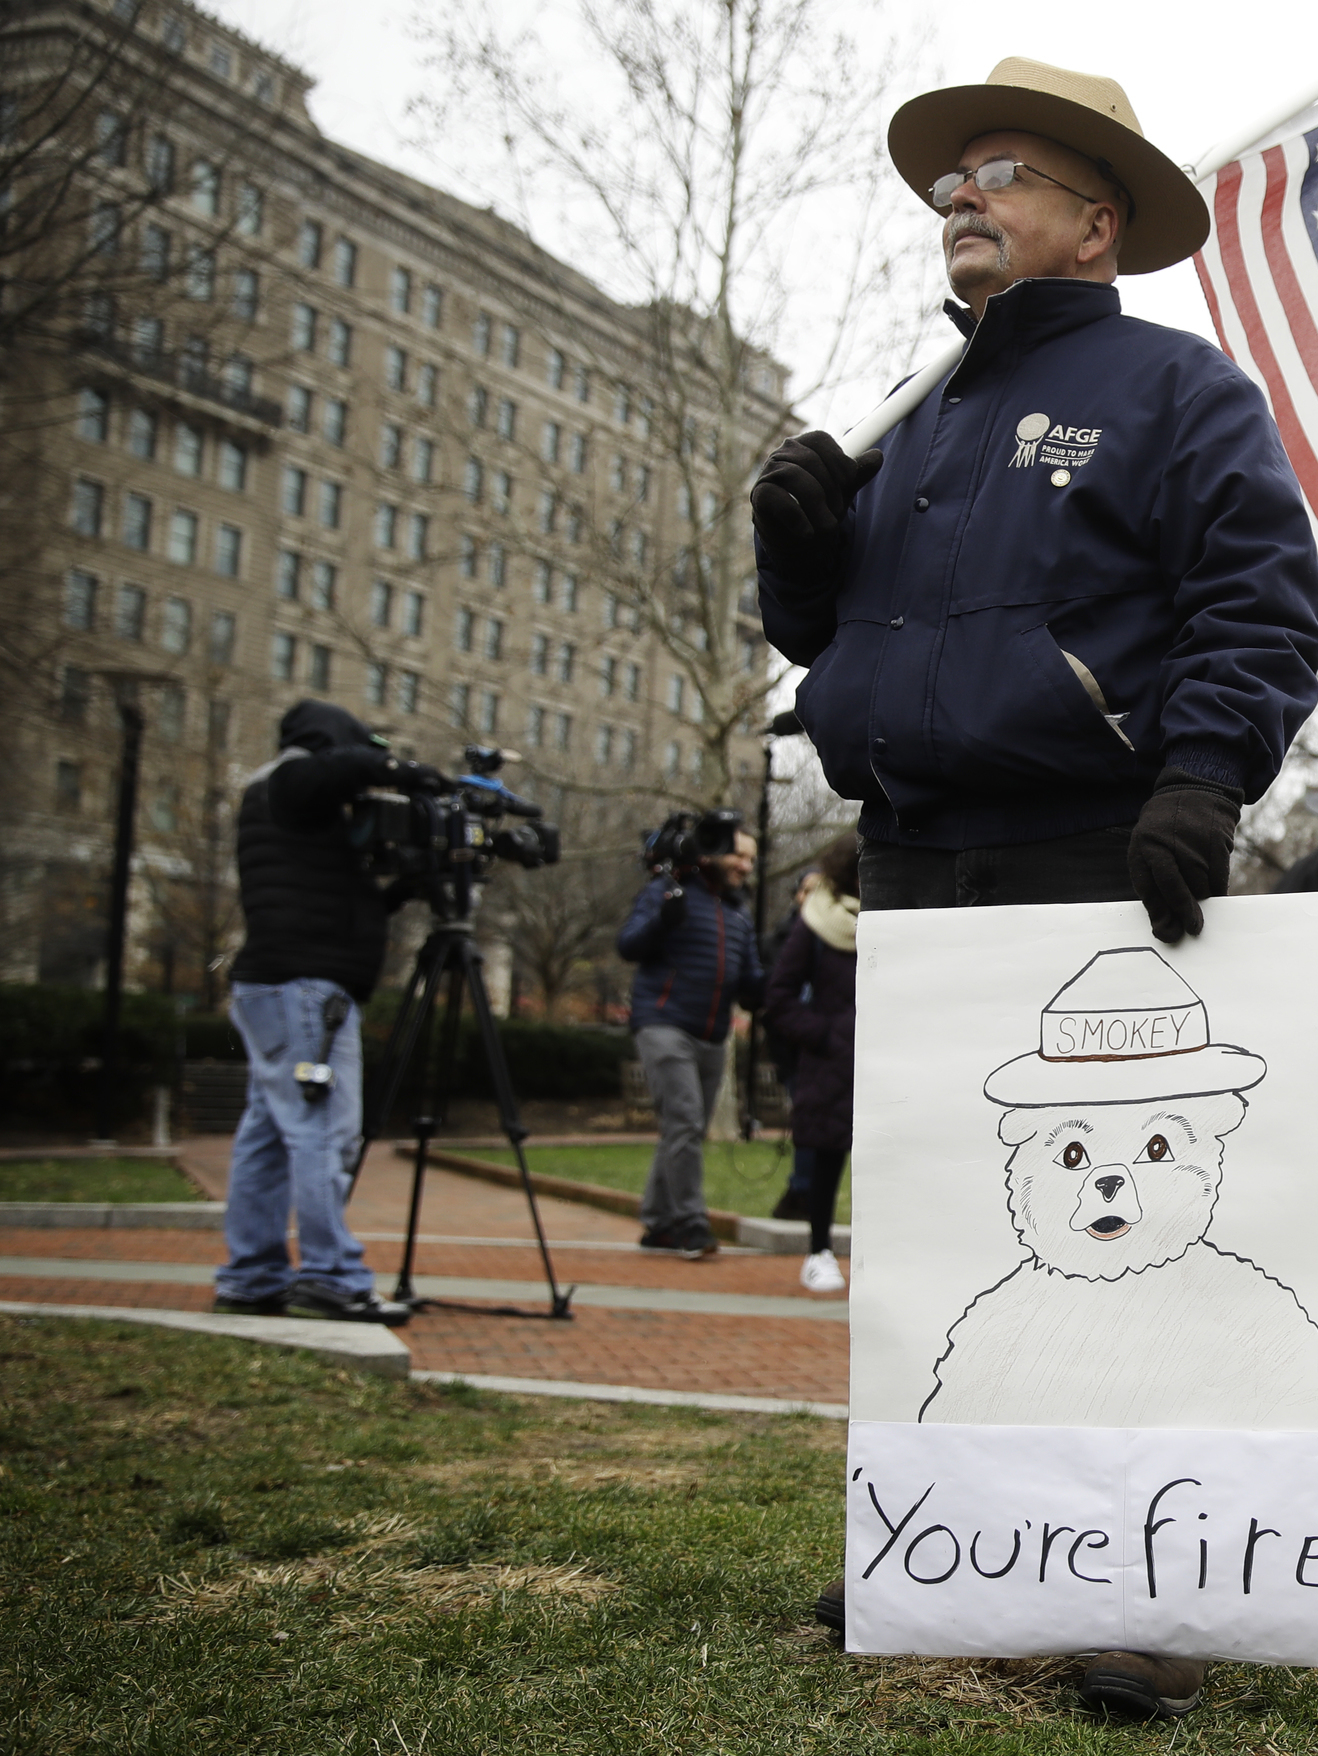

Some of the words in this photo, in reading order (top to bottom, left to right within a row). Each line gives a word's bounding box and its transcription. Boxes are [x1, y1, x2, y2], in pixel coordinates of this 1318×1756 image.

[1048, 424, 1102, 443] AFGE
[1041, 445, 1066, 456] PROUD
[1067, 449, 1077, 457] TO
[1039, 456, 1069, 467] AMERICA
[1056, 1011, 1191, 1054] SMOKEY
